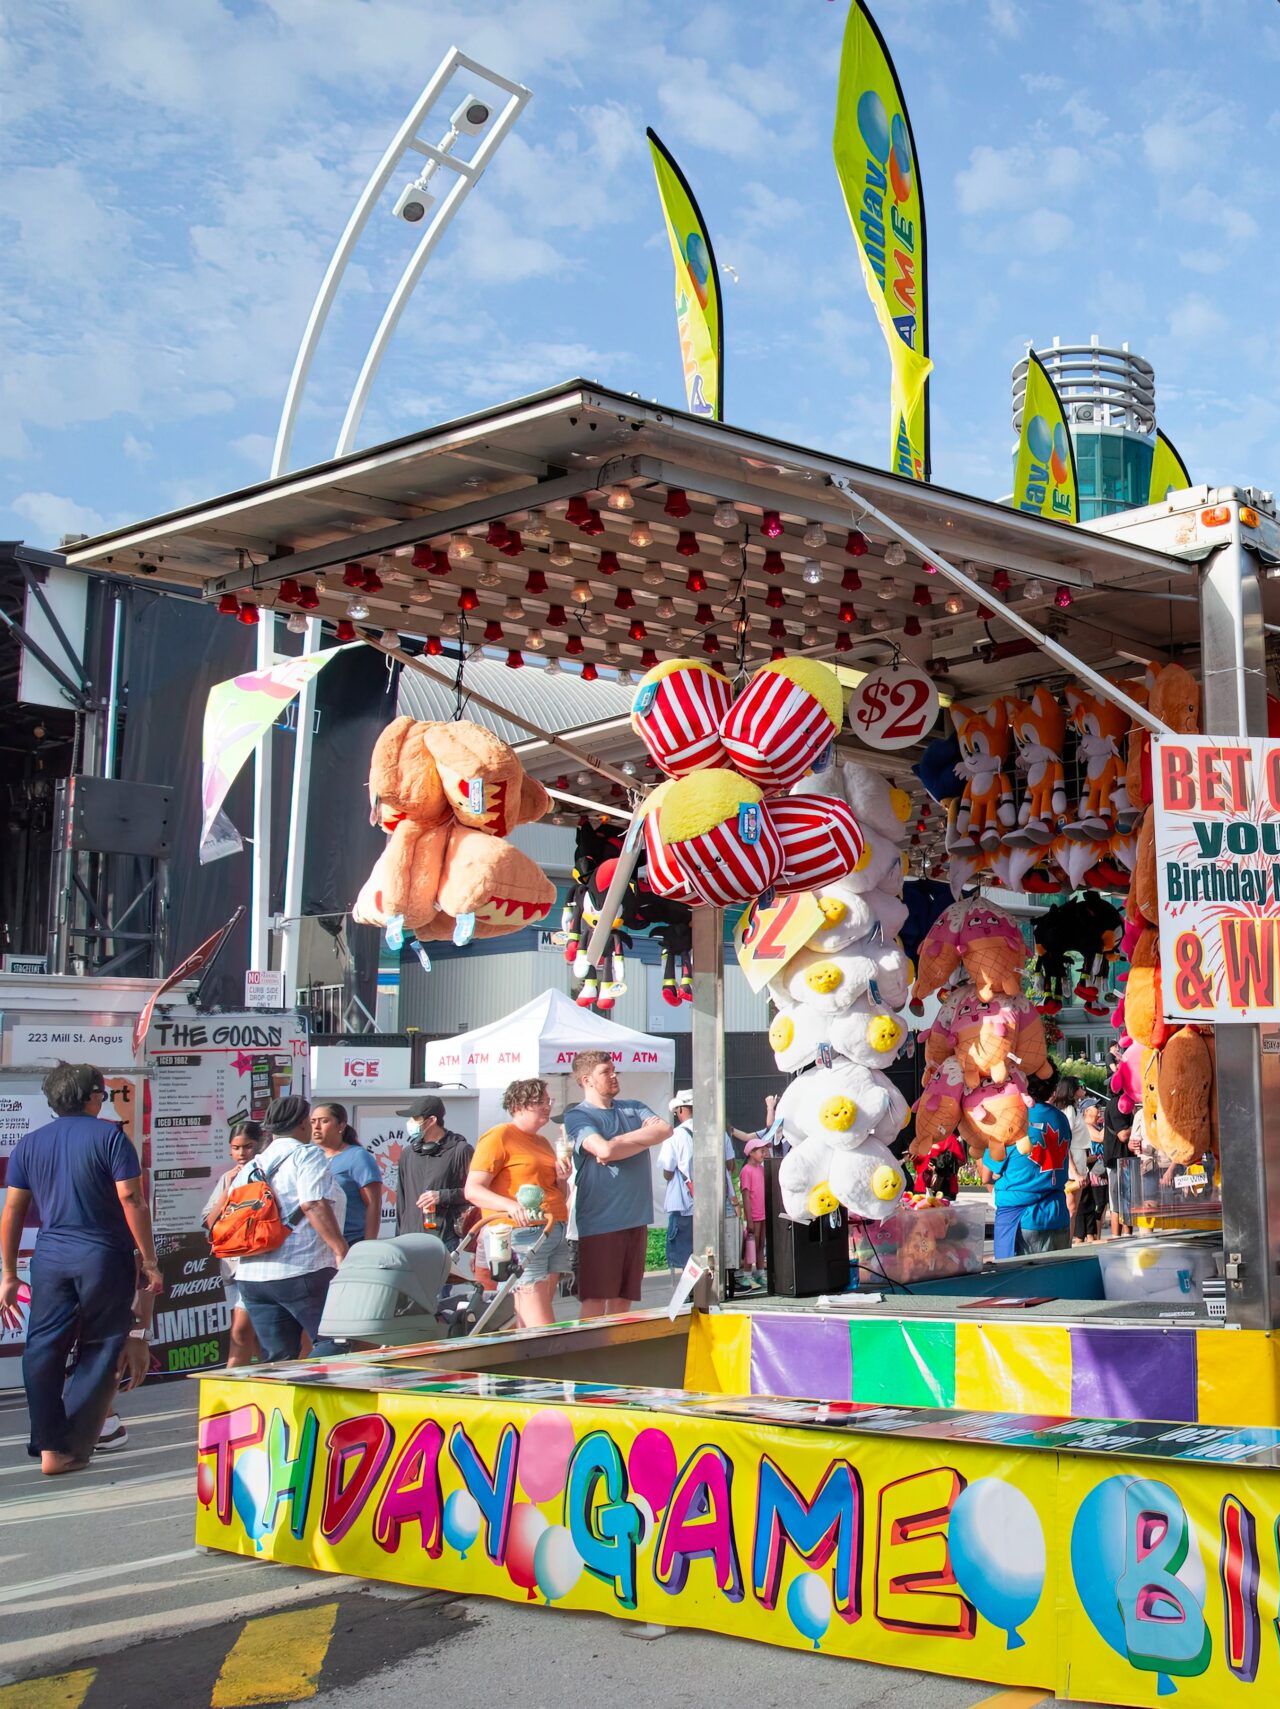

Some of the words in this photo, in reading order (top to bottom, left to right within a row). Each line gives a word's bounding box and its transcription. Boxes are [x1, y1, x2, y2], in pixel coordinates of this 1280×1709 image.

[857, 677, 930, 739] $2
[1159, 745, 1253, 814] BET
[1166, 861, 1267, 907] Birthday
[249, 972, 260, 984] NO
[1173, 930, 1216, 1012] &
[28, 1033, 49, 1044] 223
[51, 1032, 70, 1044] Mill
[73, 1032, 87, 1044] St.
[88, 1032, 123, 1046] Angus
[153, 1023, 209, 1047] THE
[212, 1024, 282, 1047] GOODS
[343, 1057, 380, 1077] ICE
[438, 1055, 461, 1067] ATM
[467, 1053, 489, 1066] ATM
[497, 1052, 521, 1064] ATM
[632, 1052, 658, 1064] ATM
[182, 1256, 209, 1276] CNE
[170, 1275, 224, 1299] TAKEOVER
[150, 1300, 232, 1346] LIMITED
[168, 1340, 219, 1371] DROPS
[1067, 1434, 1147, 1450] SEPT
[1157, 1427, 1235, 1444] OCT
[1181, 1443, 1267, 1460] NOV
[198, 1402, 521, 1567] THDAY
[563, 1429, 979, 1642] GAME
